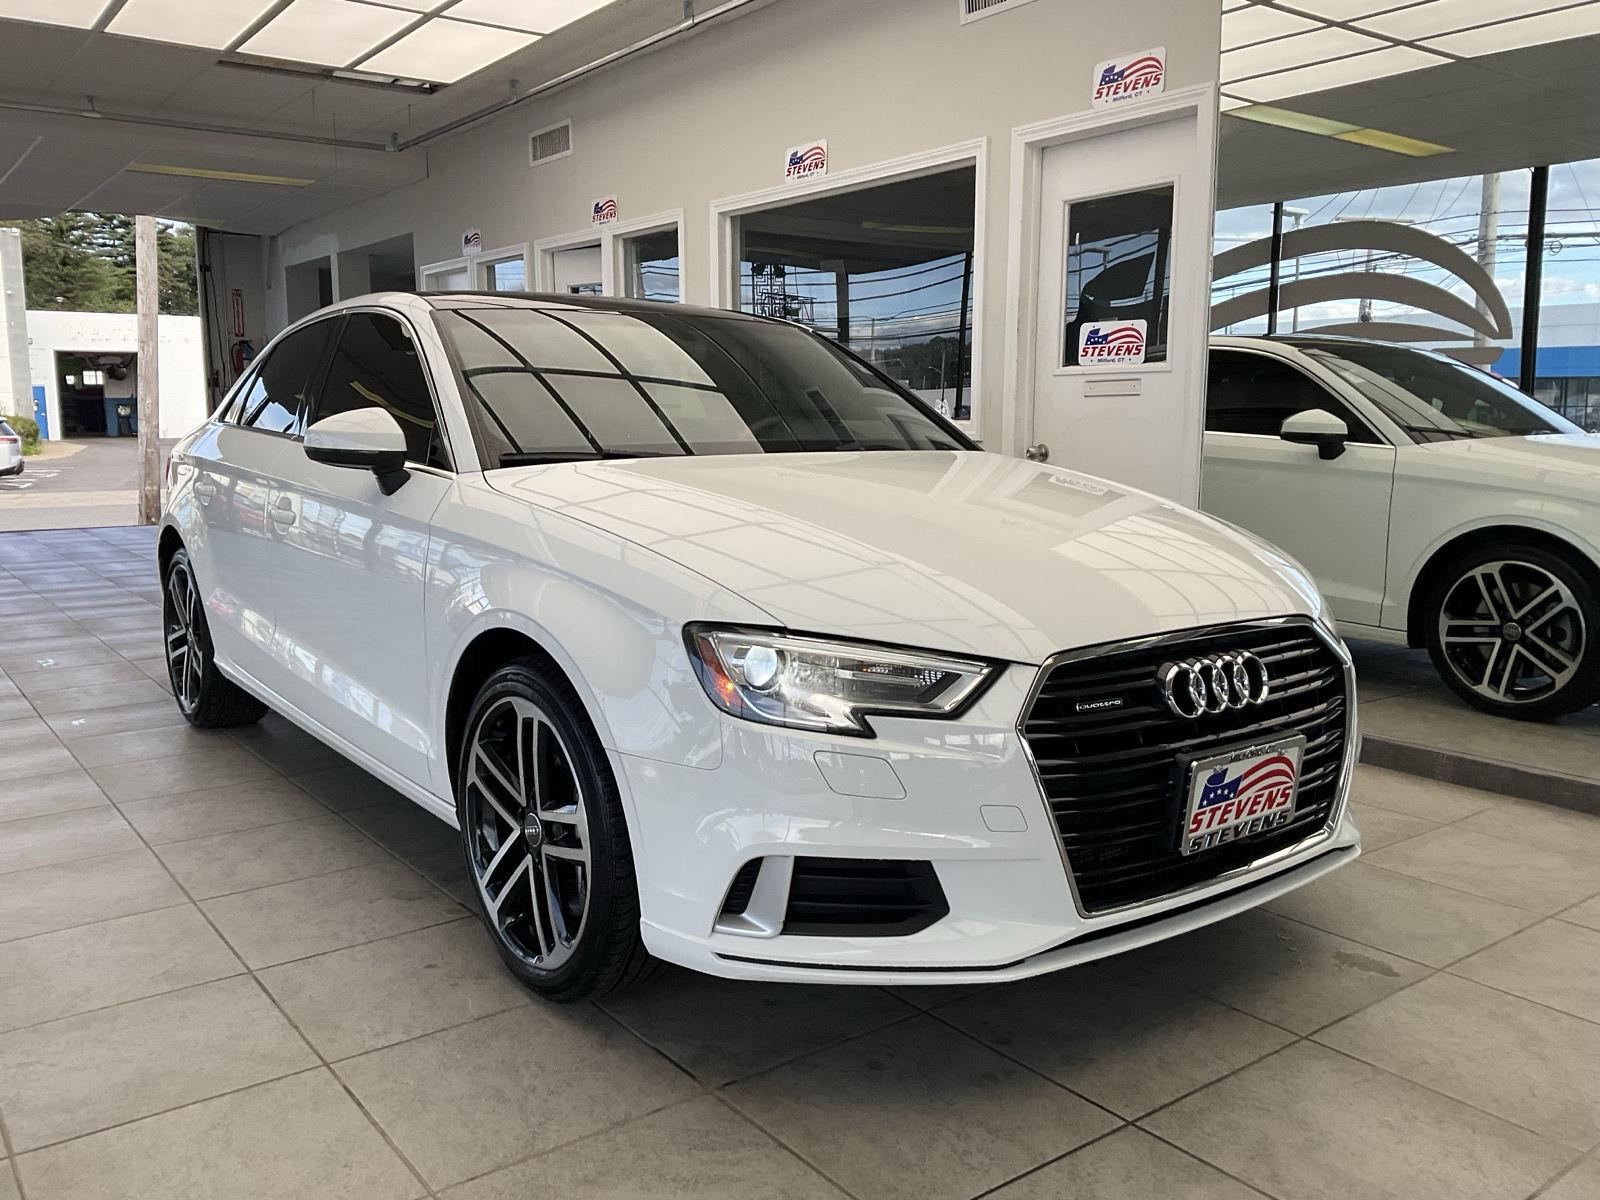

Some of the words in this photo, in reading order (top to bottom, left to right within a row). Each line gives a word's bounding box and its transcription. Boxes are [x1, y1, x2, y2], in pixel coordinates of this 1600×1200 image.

[1094, 72, 1163, 100] STEVENS
[786, 159, 826, 177] STEVENS
[592, 210, 617, 222] STEVENS
[1080, 344, 1144, 357] STEVENS
[1188, 784, 1294, 834] STEVENS
[1189, 809, 1290, 850] STEVENS
